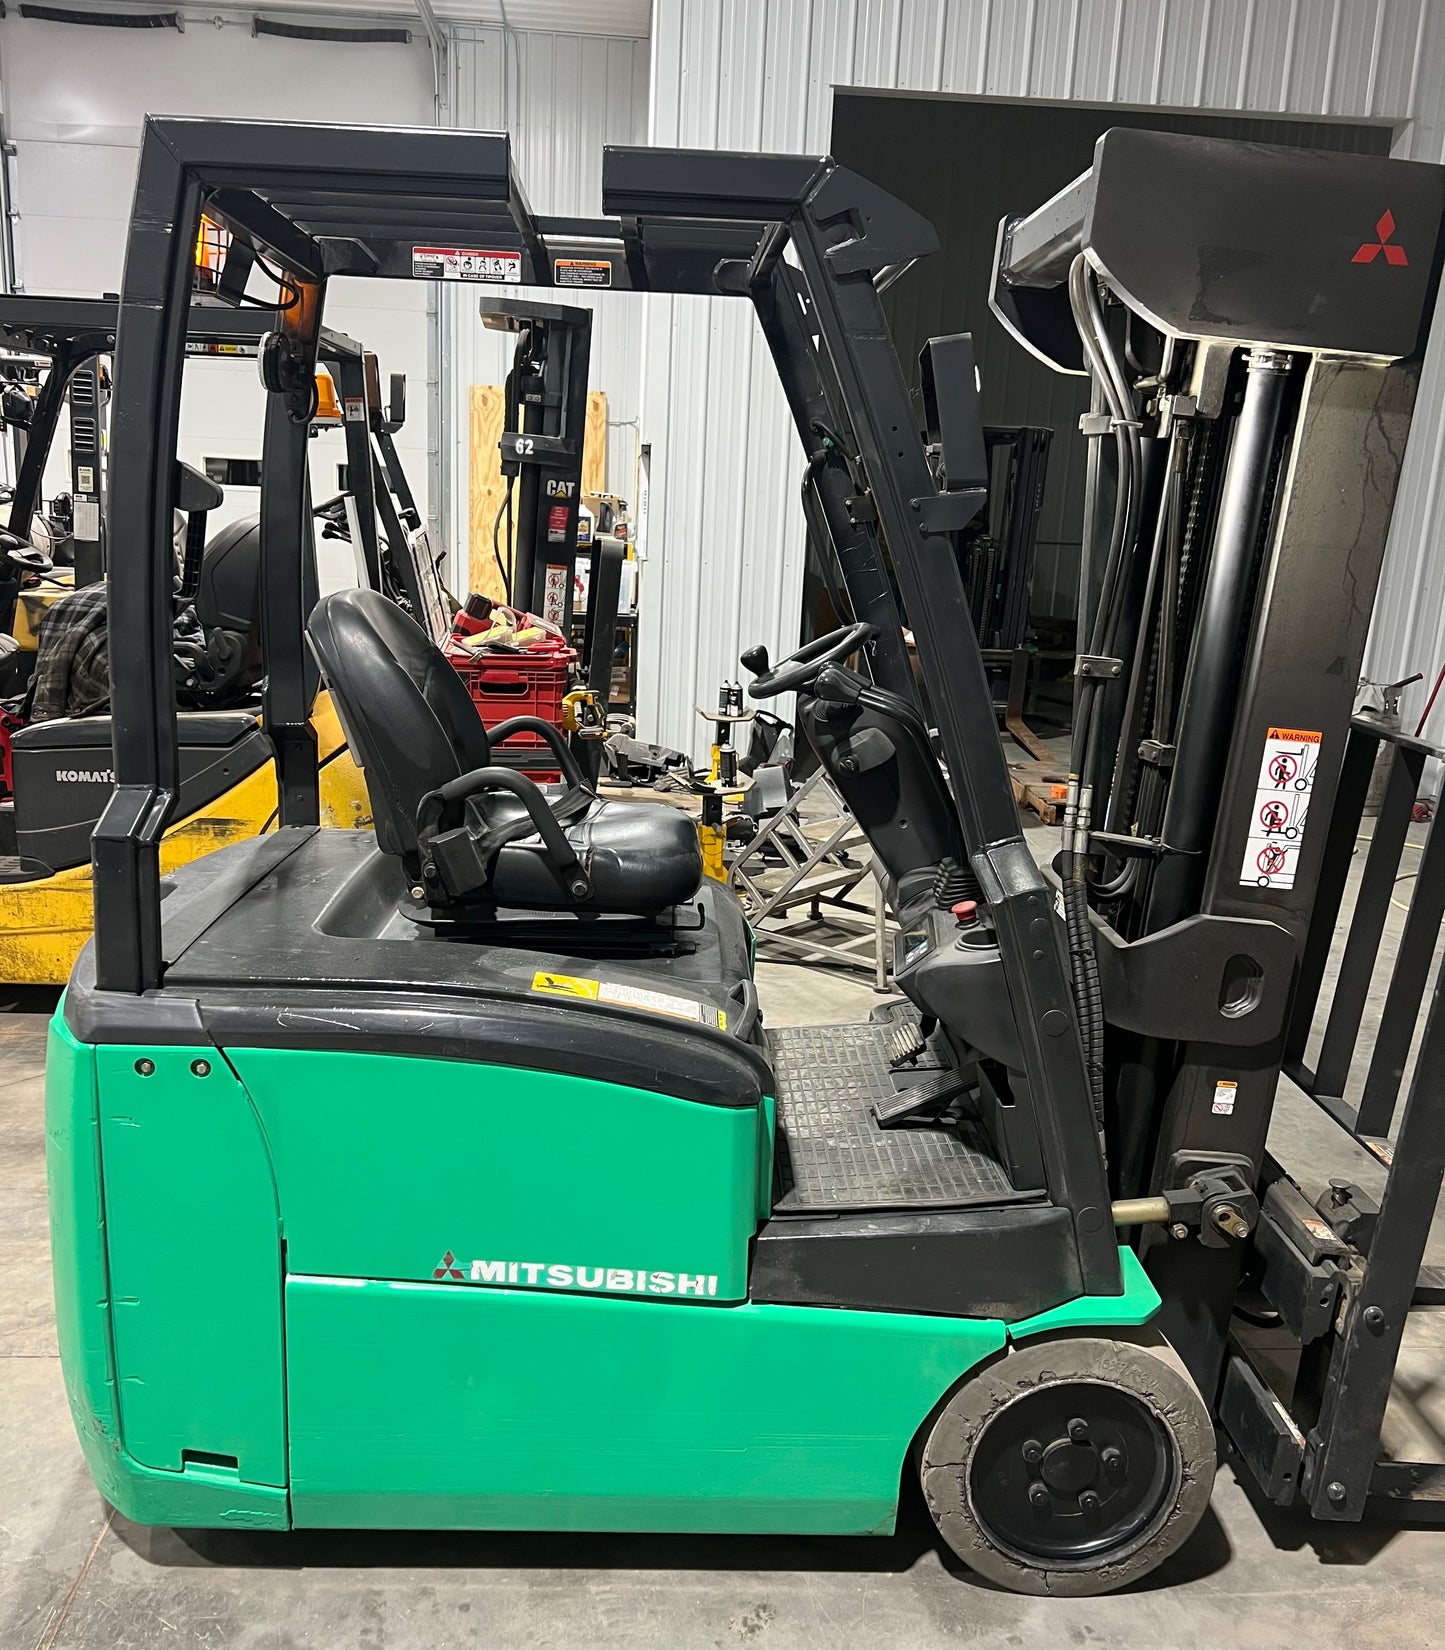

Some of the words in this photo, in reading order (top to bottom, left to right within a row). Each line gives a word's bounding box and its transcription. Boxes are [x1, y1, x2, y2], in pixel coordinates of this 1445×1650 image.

[515, 438, 534, 455] 62
[546, 480, 575, 498] CAT
[1282, 733, 1320, 743] WARNING
[56, 769, 115, 783] KOMATS
[470, 1260, 719, 1296] MITSUBISHI
